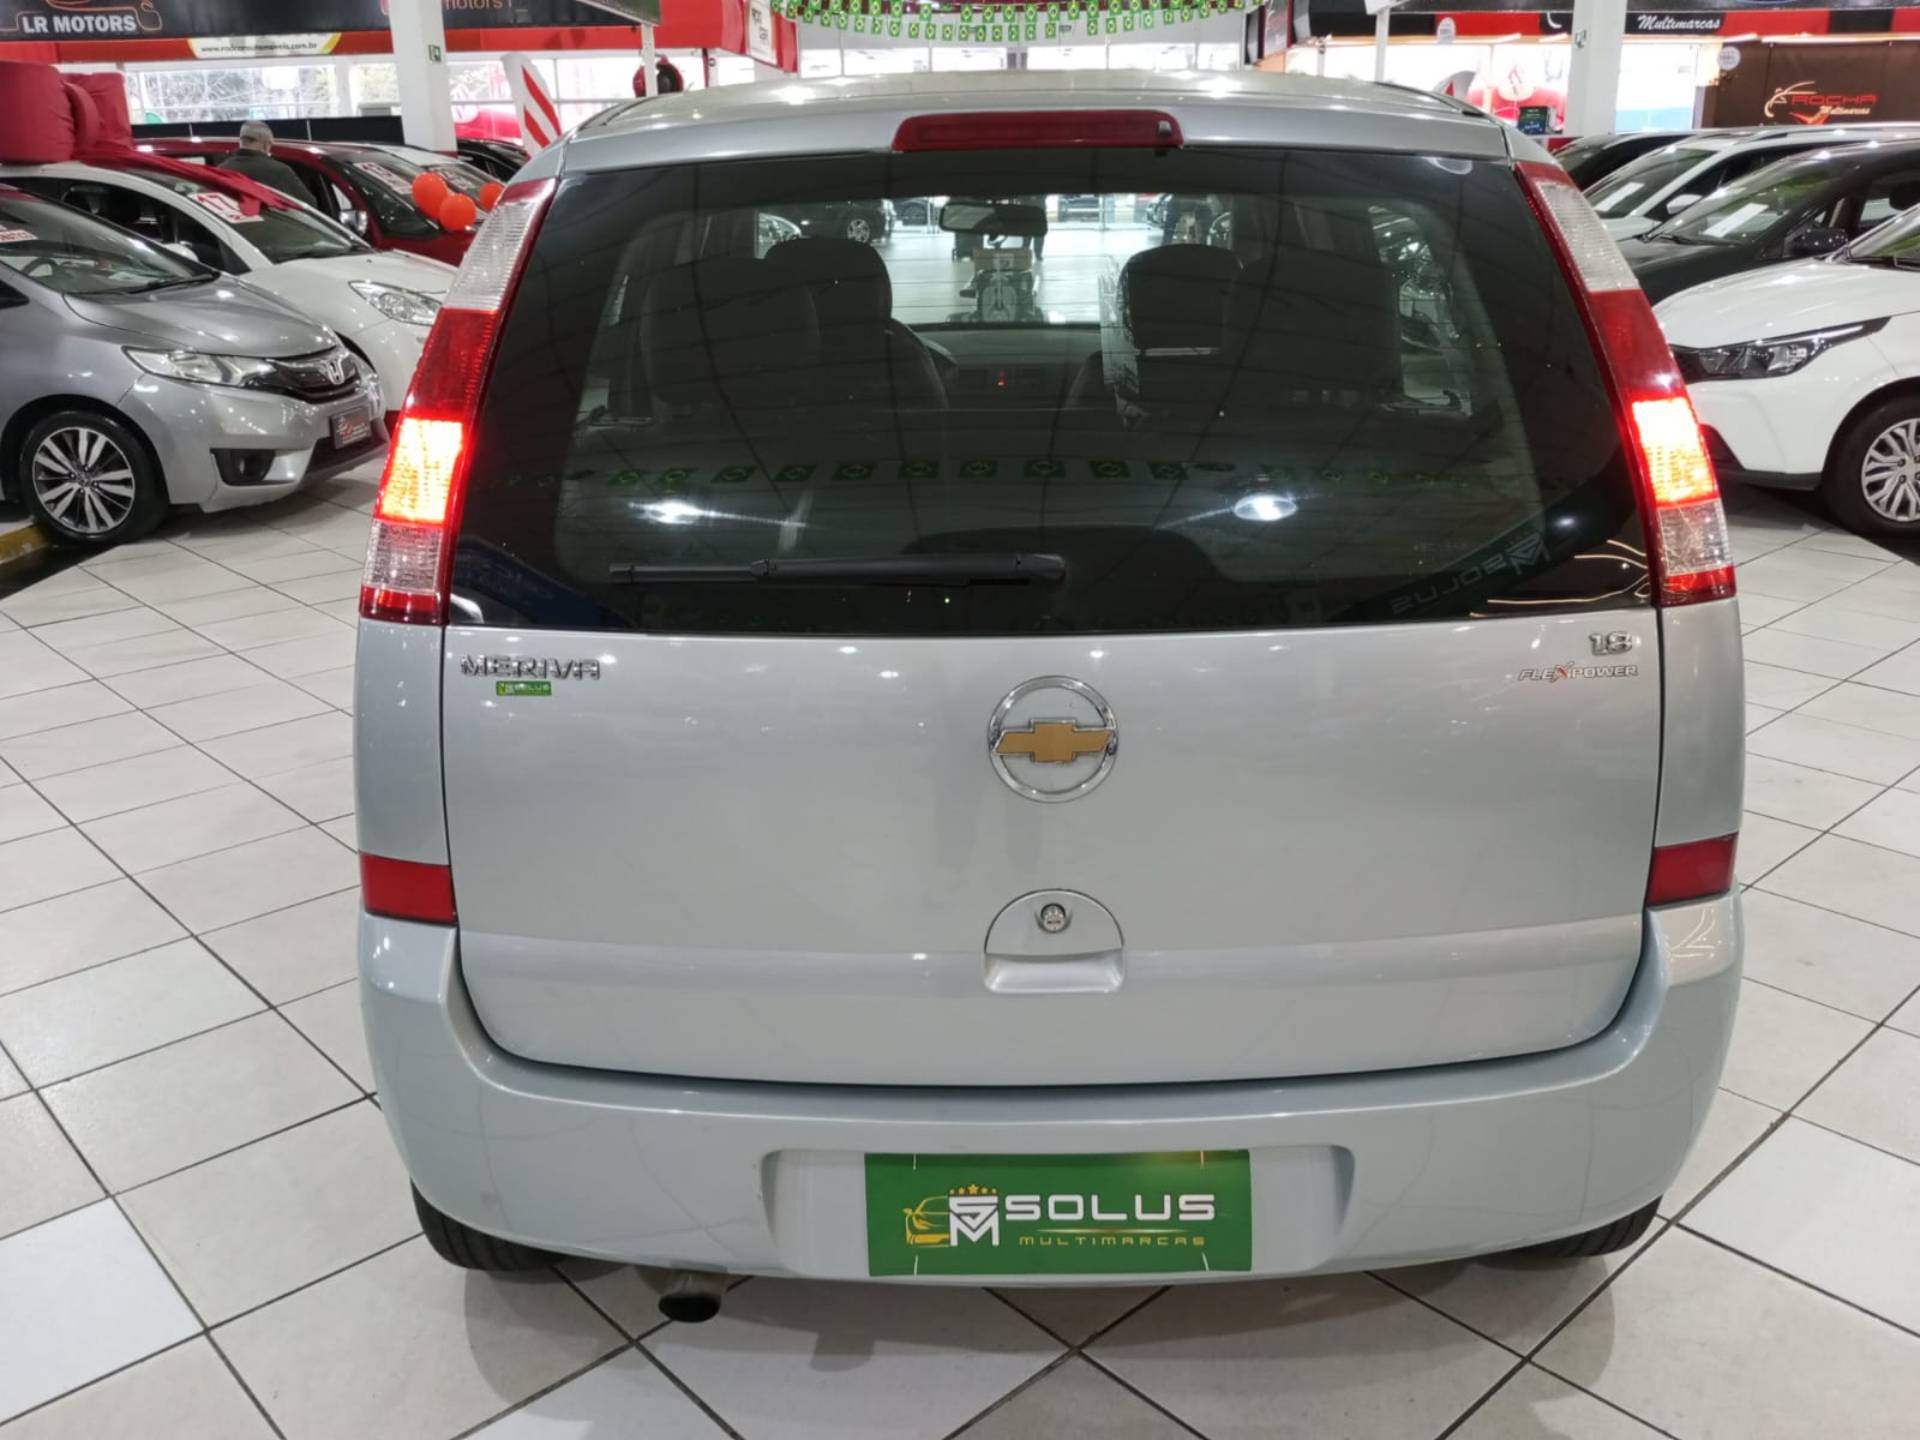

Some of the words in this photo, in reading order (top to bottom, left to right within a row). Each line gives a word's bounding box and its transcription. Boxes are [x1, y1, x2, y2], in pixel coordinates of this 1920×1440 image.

[22, 16, 48, 34] LR
[53, 15, 137, 33] MOTORS
[1637, 14, 1720, 30] Multimarcas
[1791, 94, 1877, 106] ROCHA
[461, 655, 600, 680] MERIVA
[1004, 1194, 1216, 1221] SOLUS
[1018, 1235, 1206, 1246] MULTIMARCAS
